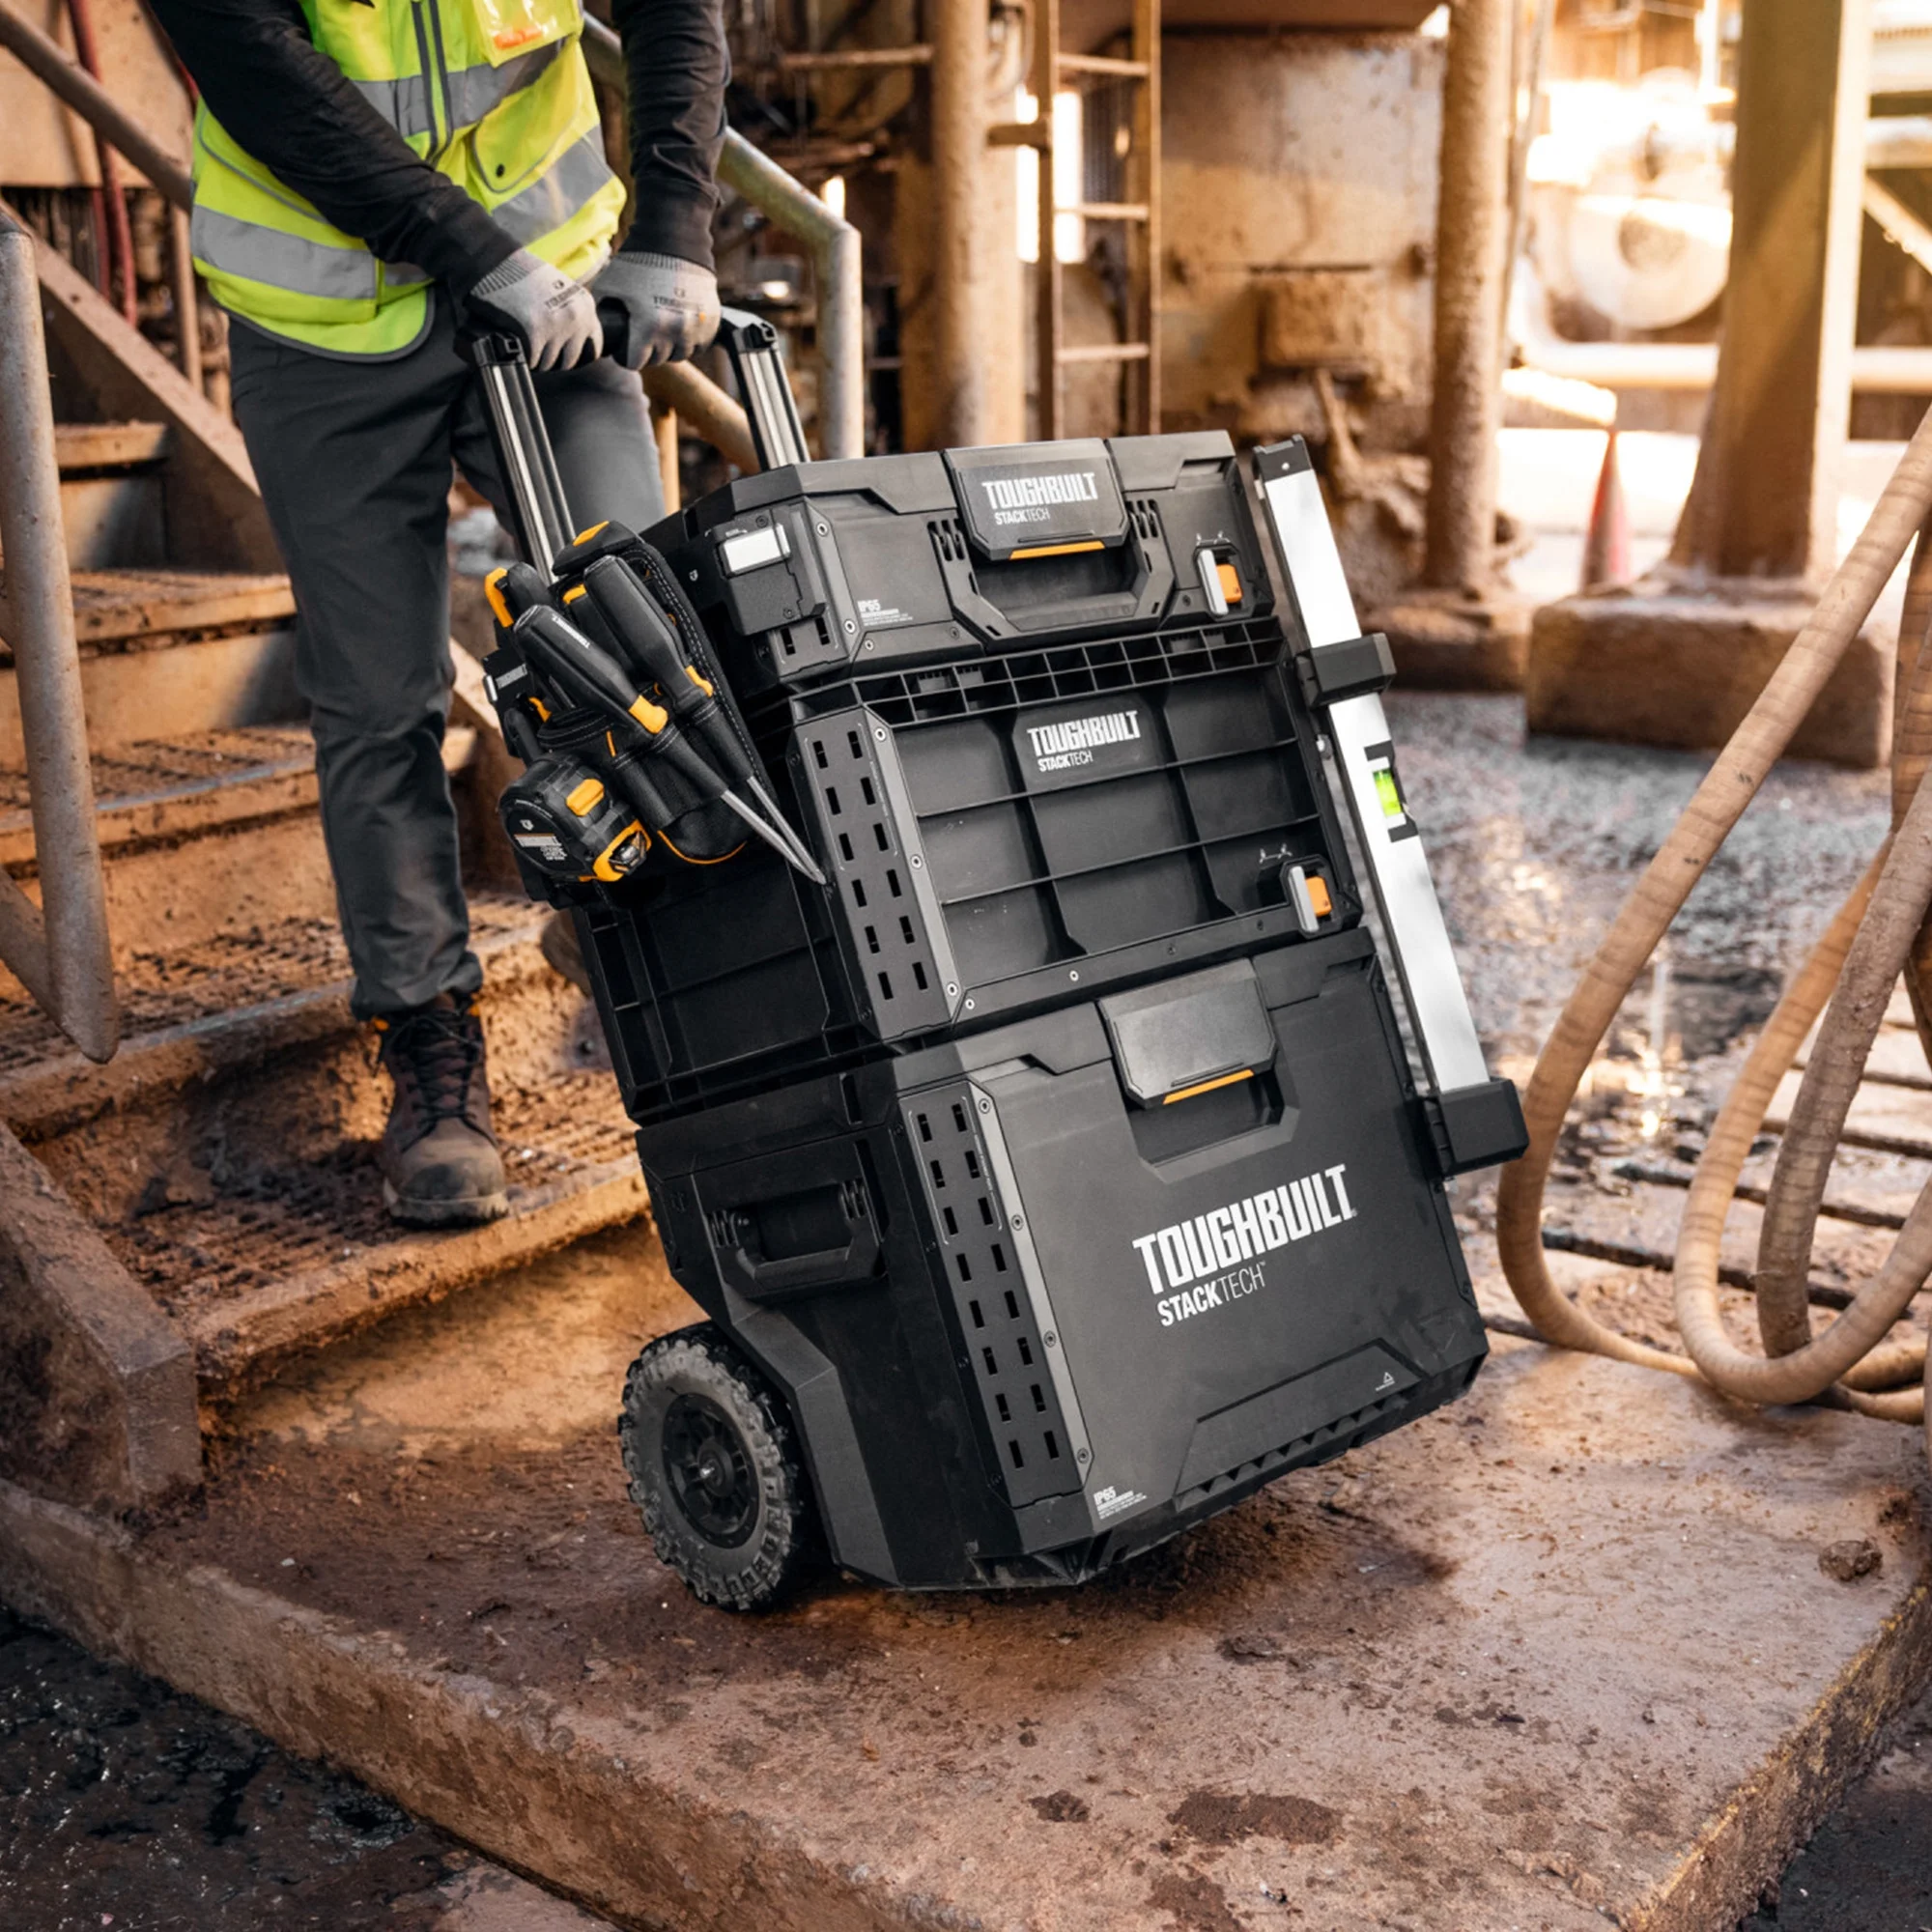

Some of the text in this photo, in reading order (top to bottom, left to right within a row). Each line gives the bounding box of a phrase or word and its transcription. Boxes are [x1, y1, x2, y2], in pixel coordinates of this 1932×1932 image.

[981, 471, 1098, 510] TOUGHBUILT
[994, 507, 1051, 526] STACKTECH
[1027, 710, 1141, 756] TOUGHBUILT
[1037, 750, 1094, 773] STACKTECH
[1132, 1163, 1353, 1295] TOUGHBUILT
